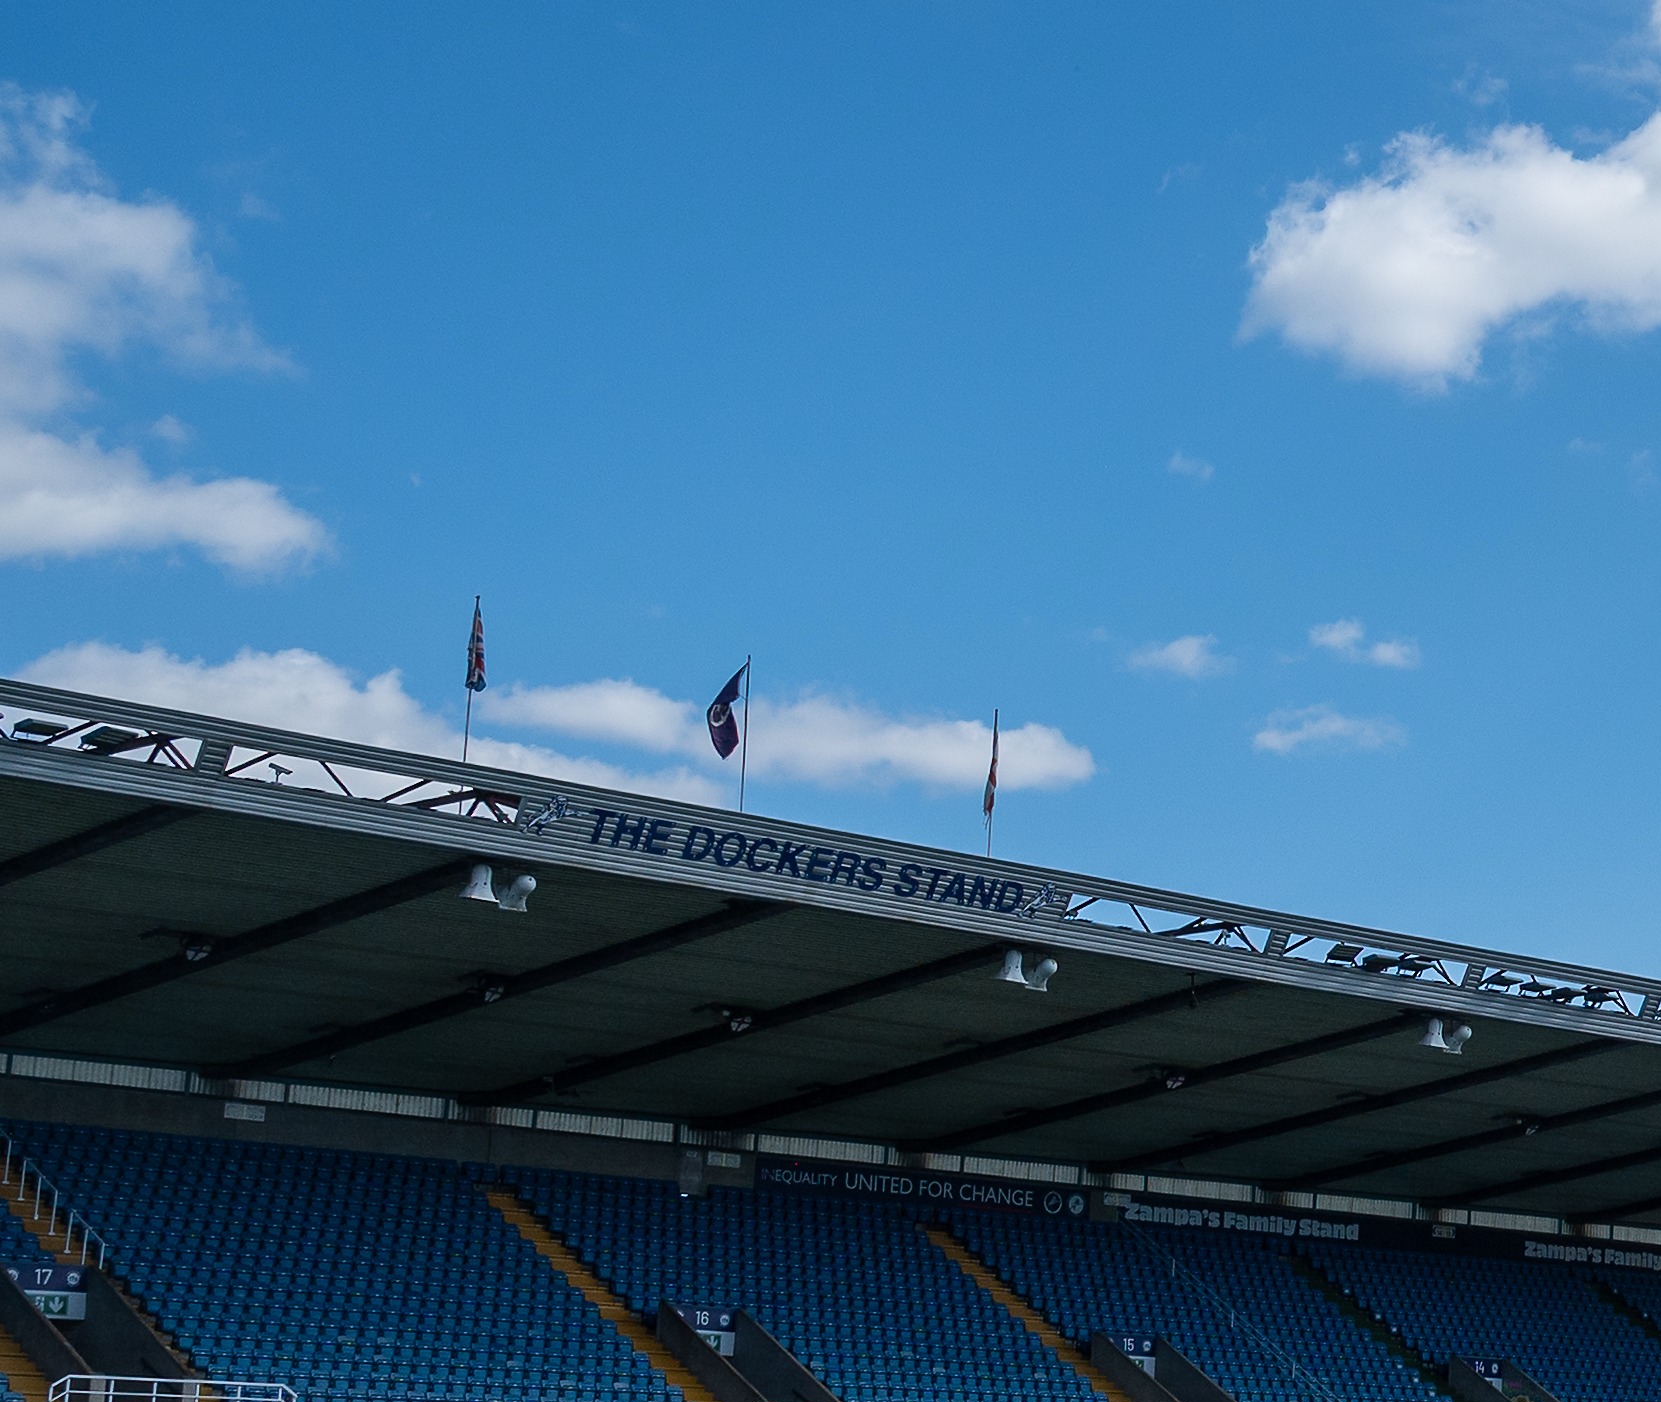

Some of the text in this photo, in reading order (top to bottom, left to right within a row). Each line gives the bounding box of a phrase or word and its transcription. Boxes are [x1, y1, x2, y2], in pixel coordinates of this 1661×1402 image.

[590, 808, 1025, 915] THE DOCKERS STAND
[761, 1168, 1034, 1208] INEQUALITY UNITED FOR CHANGE
[1124, 1202, 1359, 1241] Zampa's Family Stand
[1524, 1240, 1602, 1264] Zampa's
[34, 1268, 53, 1285] 17
[695, 1311, 709, 1326] 16
[1123, 1339, 1135, 1351] 15
[1475, 1361, 1484, 1374] 14
